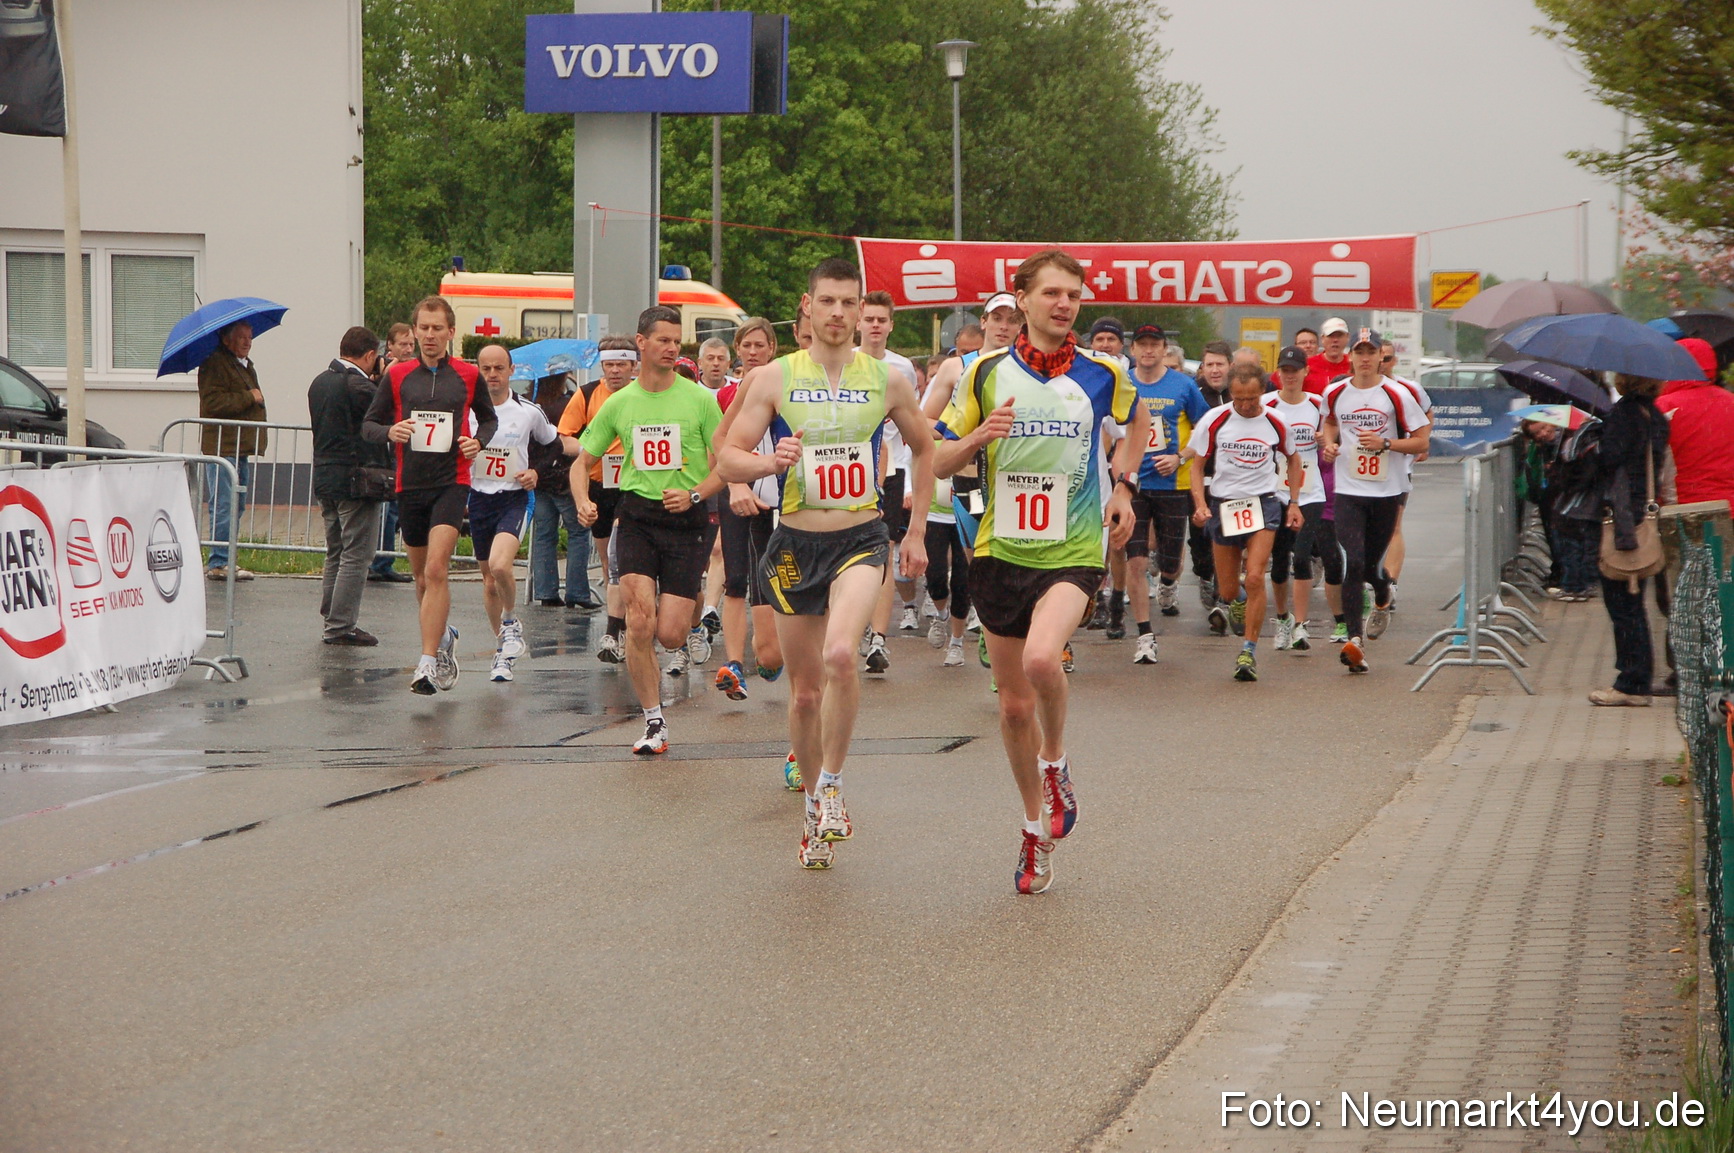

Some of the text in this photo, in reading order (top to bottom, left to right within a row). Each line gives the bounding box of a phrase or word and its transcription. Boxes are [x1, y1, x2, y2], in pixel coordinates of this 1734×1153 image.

[546, 43, 719, 78] VOLVO
[790, 388, 870, 403] BOCK
[1341, 413, 1379, 421] GERHART
[424, 423, 436, 446] 7
[1009, 420, 1082, 439] BOCK
[643, 439, 671, 466] 68
[815, 447, 846, 457] MEYER
[1222, 442, 1264, 451] GERHART
[485, 456, 506, 477] 75
[1357, 455, 1380, 476] 38
[814, 462, 866, 500] 100
[1007, 475, 1039, 484] MEYER
[1015, 493, 1050, 532] 10
[1233, 509, 1254, 530] 18
[110, 531, 129, 564] KIA
[149, 548, 180, 564] NISSAN
